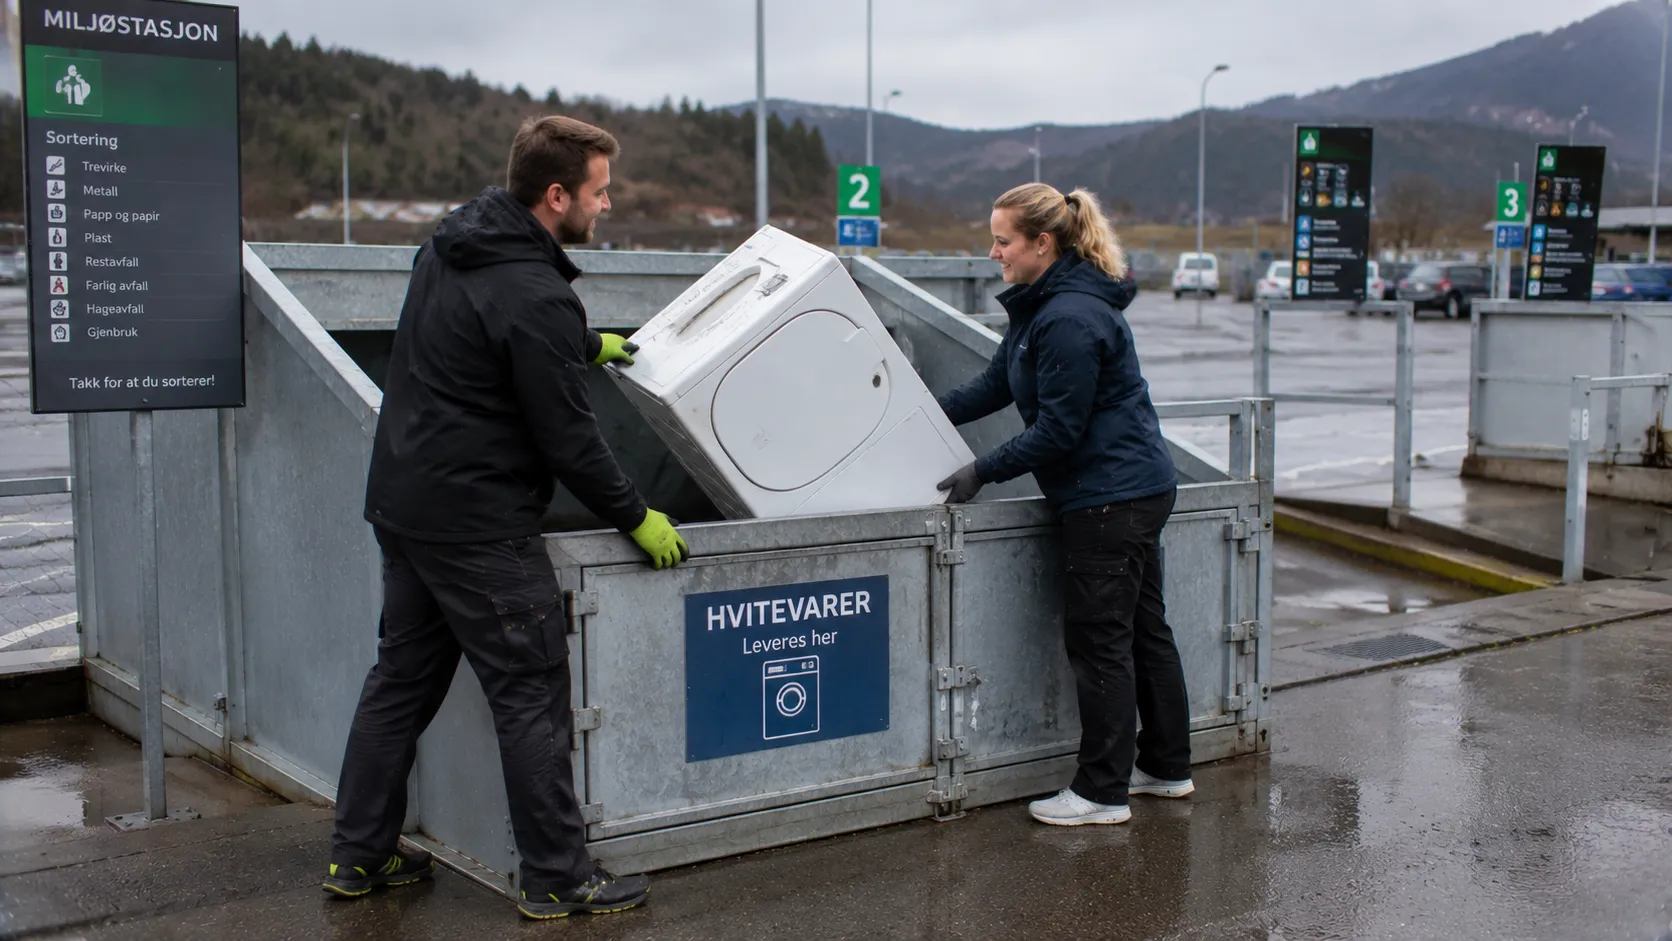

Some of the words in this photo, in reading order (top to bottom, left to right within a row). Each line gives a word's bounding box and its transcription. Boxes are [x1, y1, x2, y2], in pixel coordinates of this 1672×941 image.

[44, 9, 218, 42] MILJØSTASJON
[46, 131, 118, 149] Sortering
[82, 161, 126, 174] Trevirke
[84, 185, 118, 197] Metall
[849, 173, 870, 208] 2
[1504, 188, 1519, 217] 3
[84, 209, 112, 222] Papp
[116, 212, 128, 222] og
[132, 211, 159, 223] papir
[85, 232, 112, 243] Plast
[86, 256, 139, 268] Restavfall
[86, 280, 116, 293] Farlig
[119, 280, 148, 291] avfall
[87, 303, 144, 316] Hageavfall
[88, 326, 138, 338] Gjenbruk
[70, 377, 101, 389] Takk
[104, 377, 123, 389] for
[126, 377, 139, 388] at
[142, 376, 158, 387] du
[162, 375, 215, 387] sorterer!
[708, 591, 871, 631] HVITEVARER
[744, 635, 806, 654] Leveres
[813, 630, 837, 646] her
